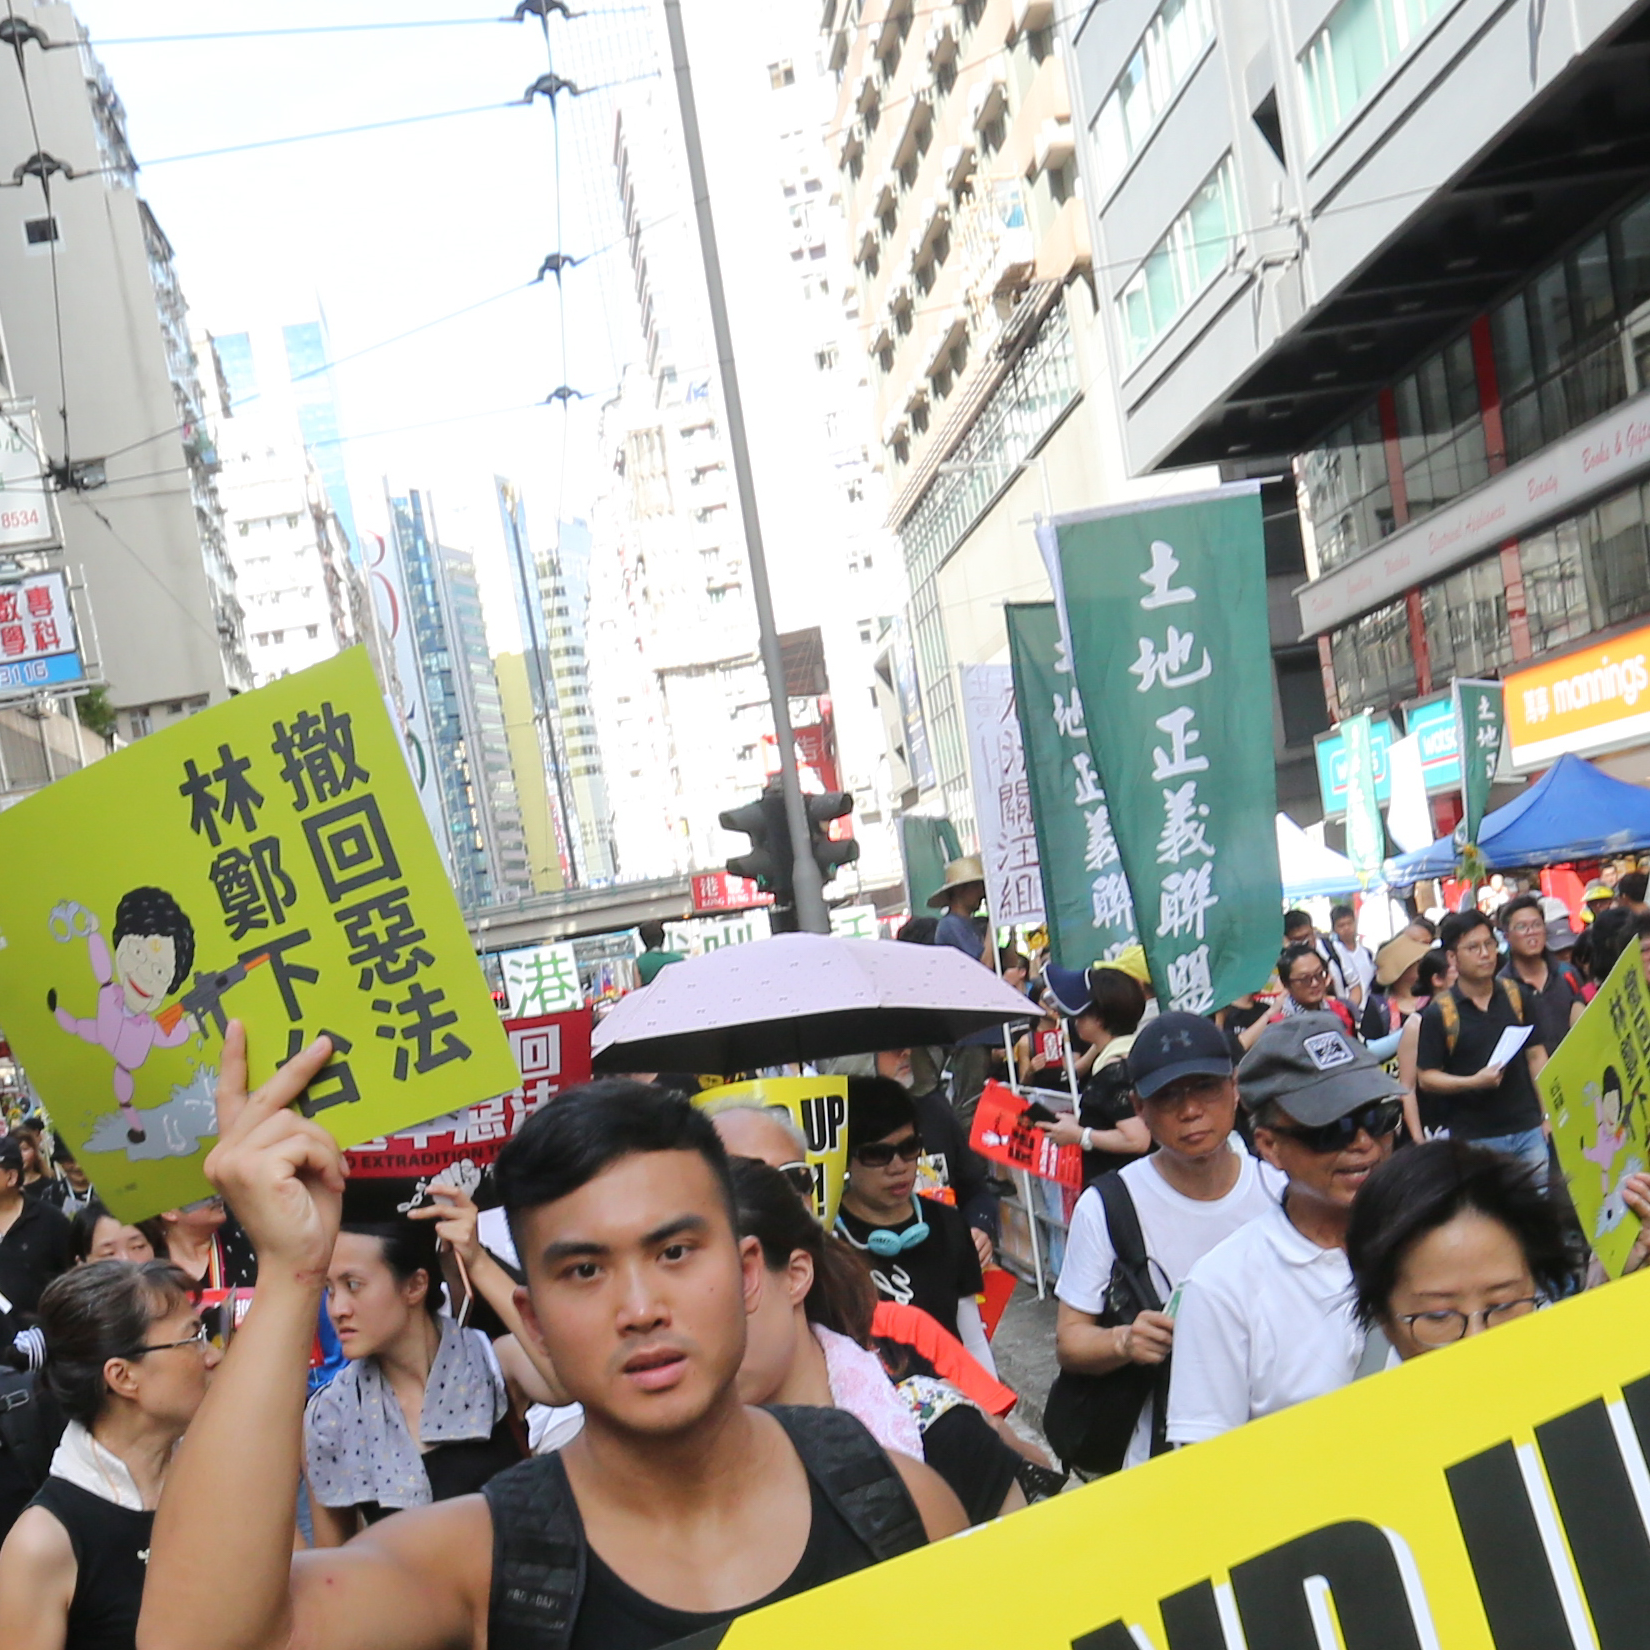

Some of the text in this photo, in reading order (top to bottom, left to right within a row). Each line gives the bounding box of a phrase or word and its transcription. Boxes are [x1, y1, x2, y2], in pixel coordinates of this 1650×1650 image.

[1, 508, 40, 530] 8534
[0, 660, 49, 686] 3116
[1552, 654, 1649, 715] mannings
[996, 685, 1043, 920] 關注組
[1128, 540, 1219, 1015] 土地正義聯盟
[272, 702, 472, 1083] 撤回惡法
[179, 743, 361, 1119] 林鄭下台
[510, 952, 577, 1018] 港
[509, 1024, 561, 1082] 回
[803, 1094, 847, 1153] UP
[361, 1144, 484, 1169] EXTRADITION
